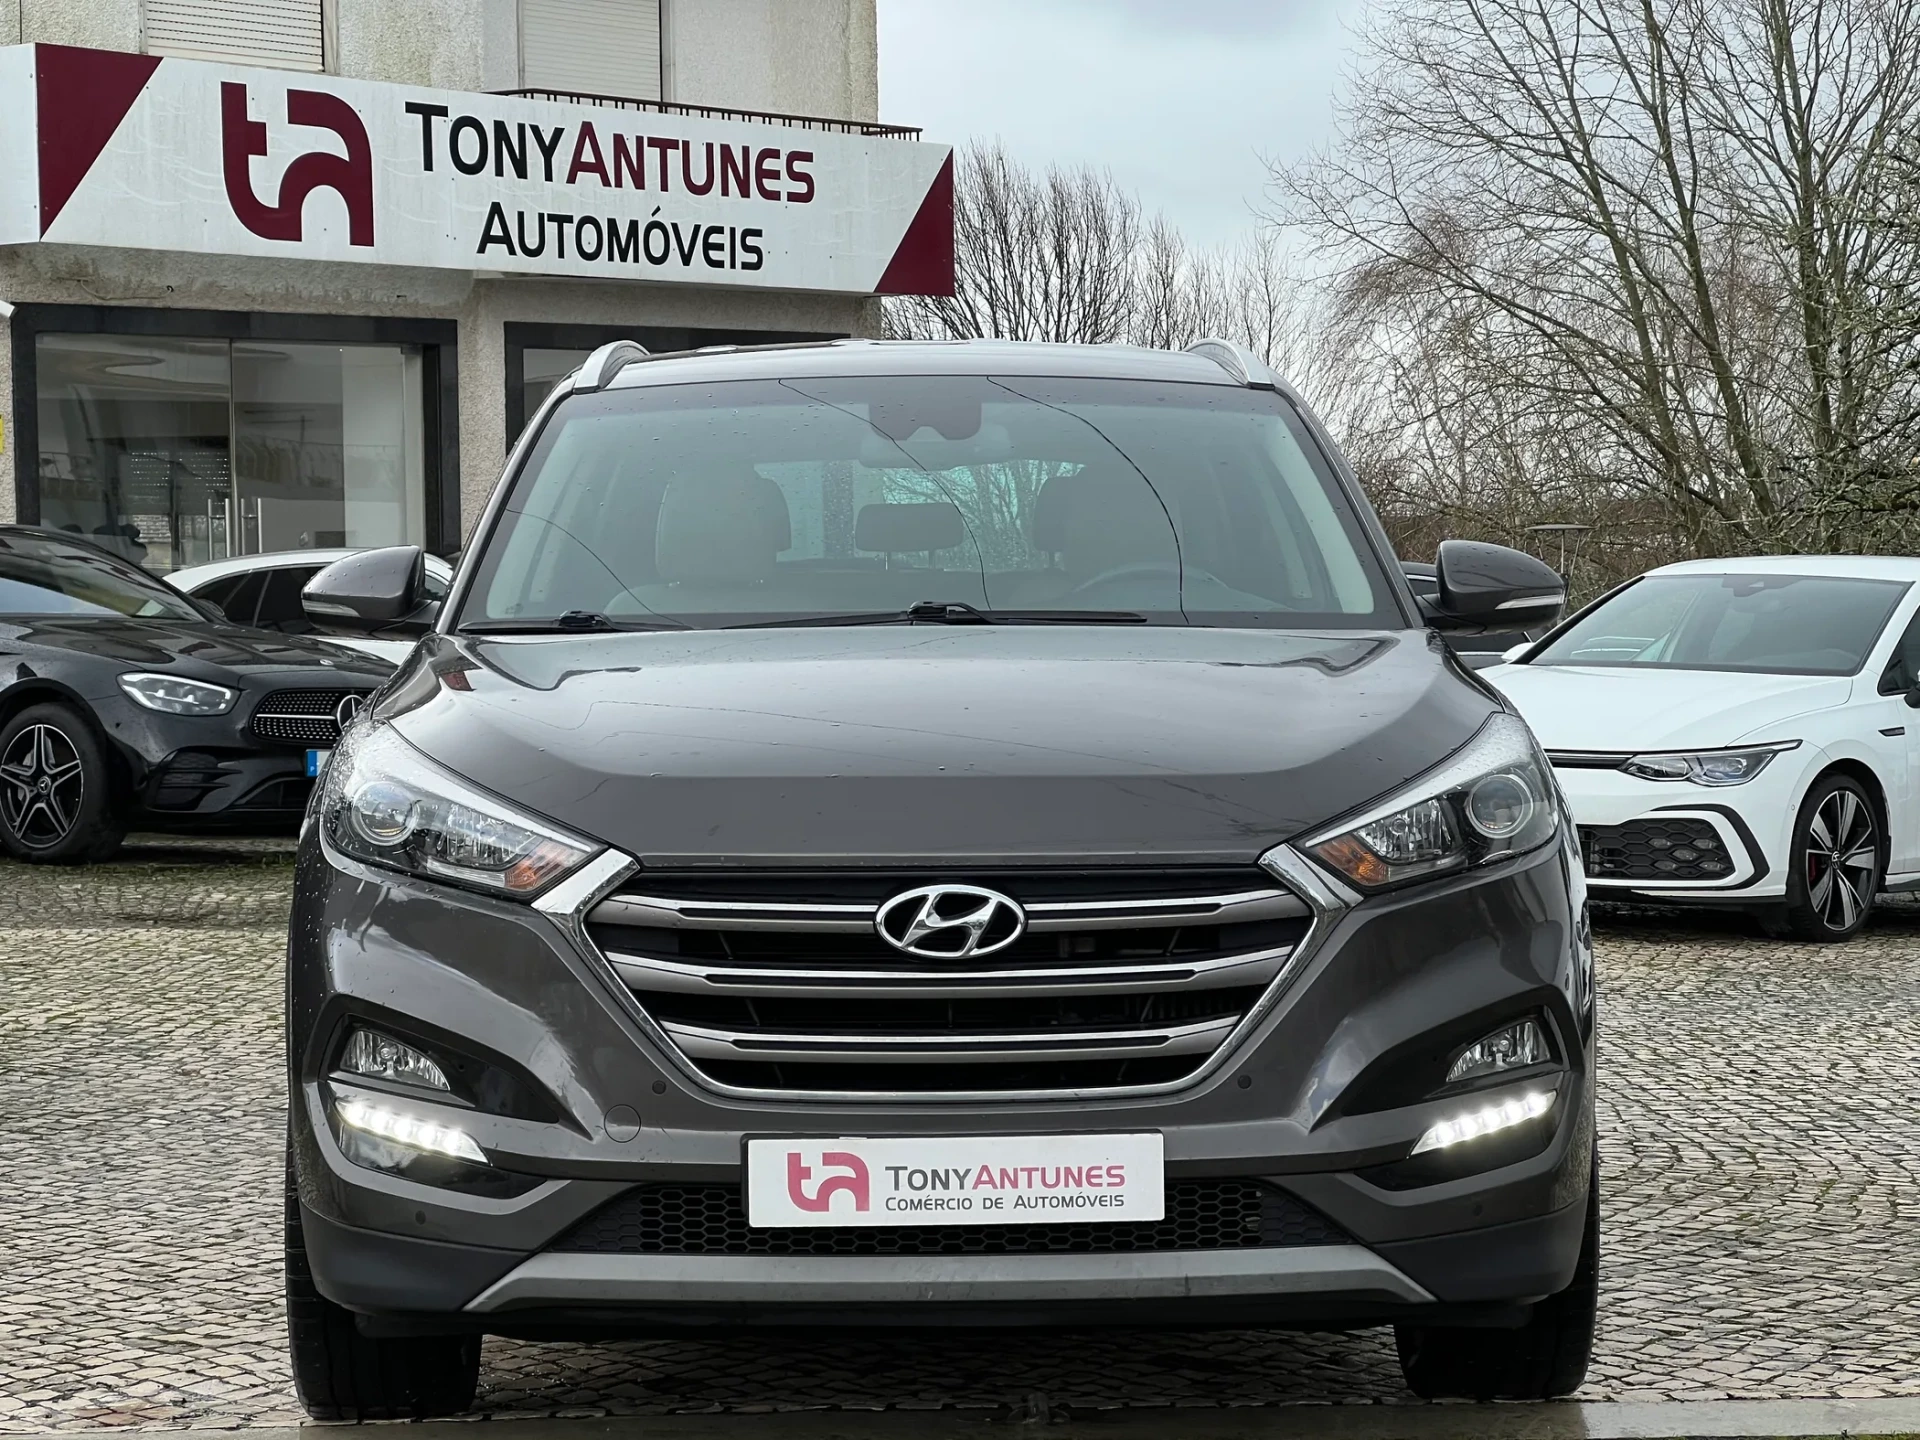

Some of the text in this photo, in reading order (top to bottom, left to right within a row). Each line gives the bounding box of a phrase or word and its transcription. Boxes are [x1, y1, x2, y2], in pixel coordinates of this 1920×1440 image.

[476, 201, 764, 271] AUTOMÓVEIS
[885, 1191, 1125, 1212] COMÉRCIO DE AUTOMÓVEIS
